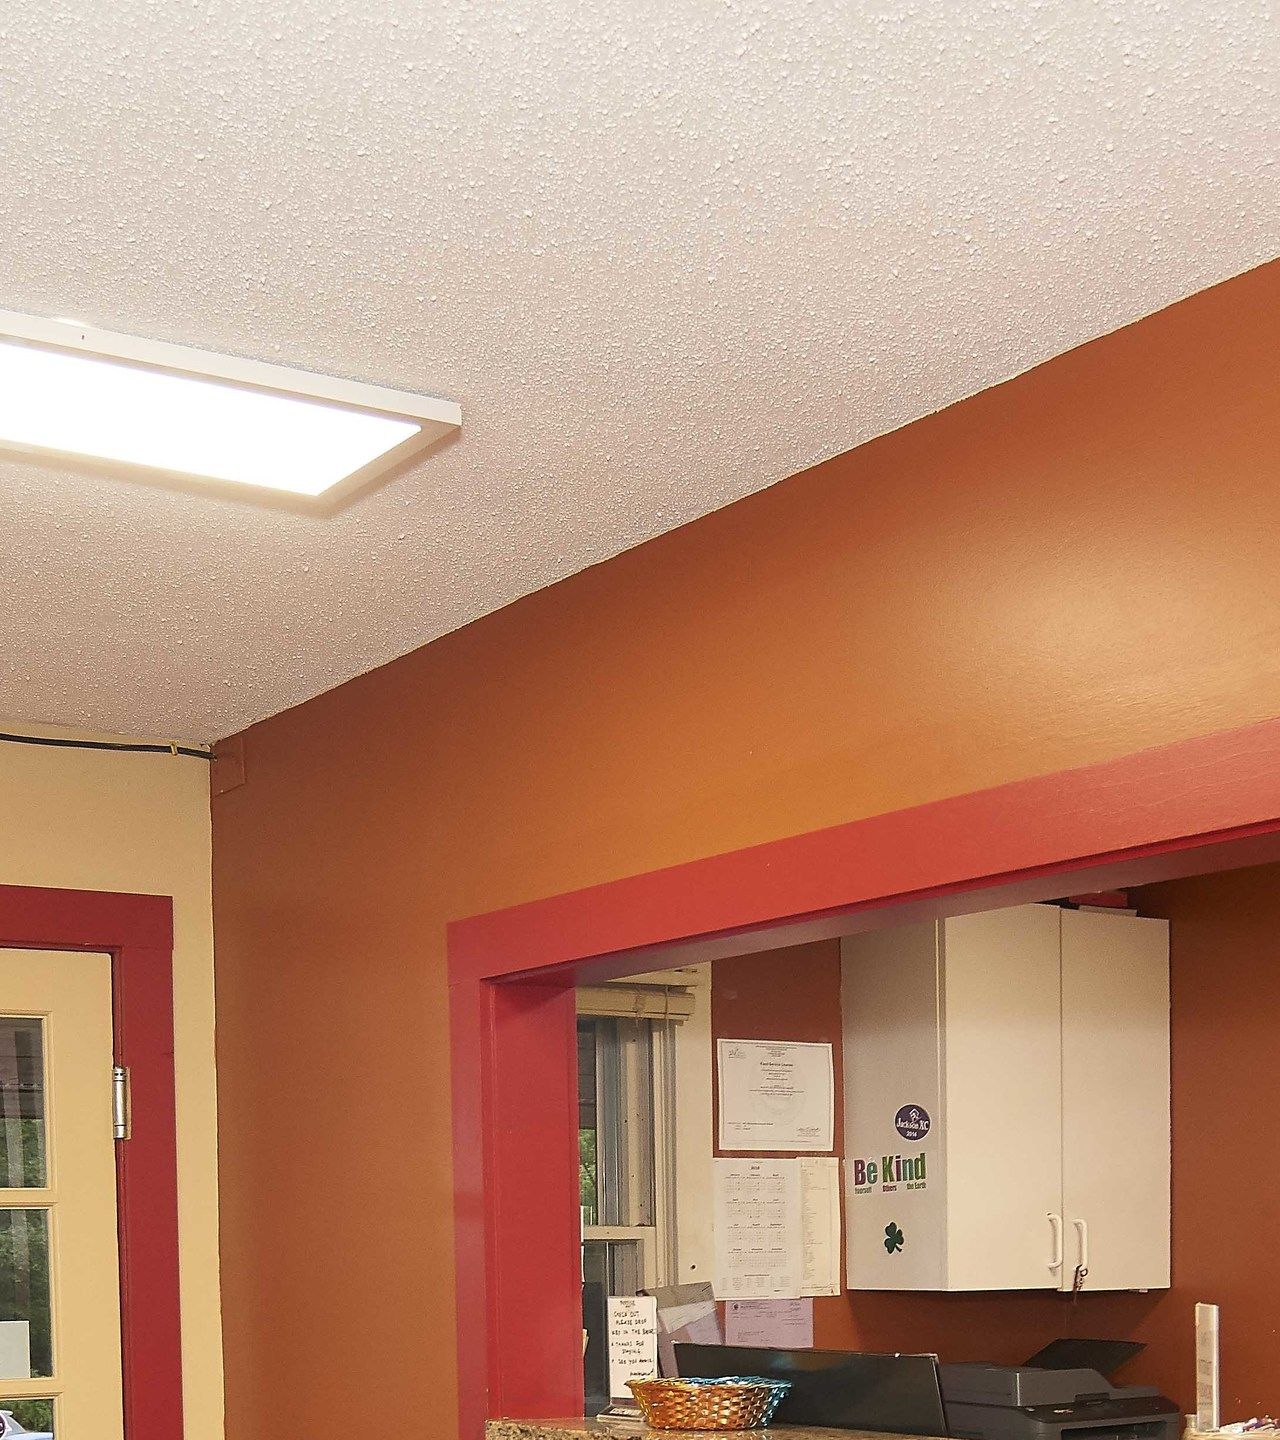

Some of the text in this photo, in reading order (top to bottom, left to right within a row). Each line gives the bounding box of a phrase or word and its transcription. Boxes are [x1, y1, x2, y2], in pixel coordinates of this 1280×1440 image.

[896, 1117, 929, 1131] Jackson XC
[854, 1152, 926, 1185] Be Kind
